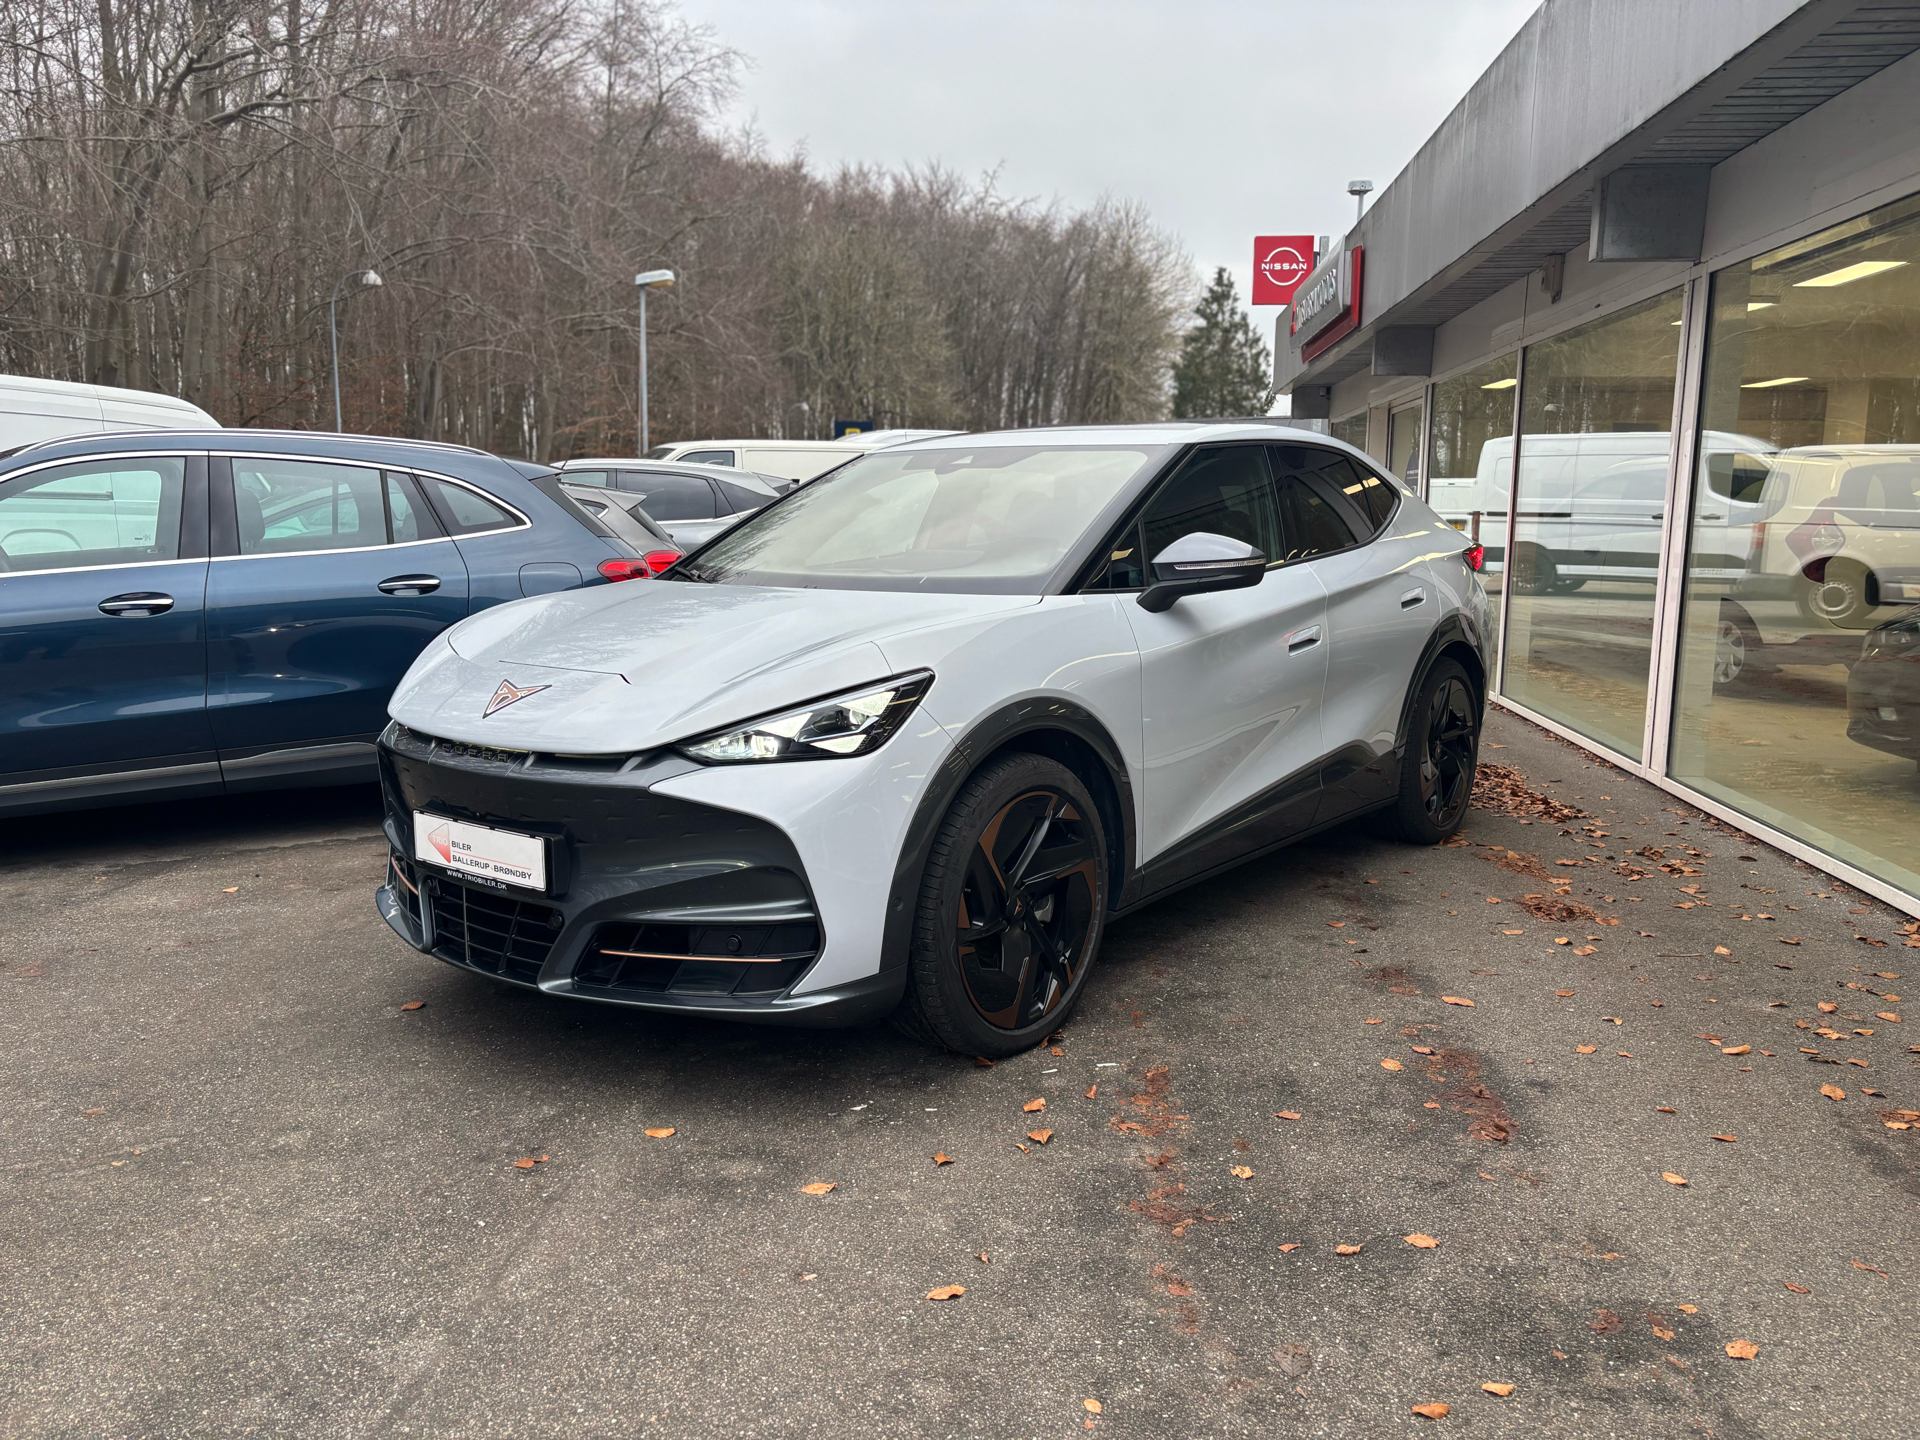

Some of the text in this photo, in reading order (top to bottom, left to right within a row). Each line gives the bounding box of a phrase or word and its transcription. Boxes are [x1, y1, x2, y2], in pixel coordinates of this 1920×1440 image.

[1261, 262, 1307, 270] NISSAN
[442, 743, 508, 763] CUPRA
[432, 835, 472, 852] TRIO BILER
[452, 854, 532, 880] BALLERUP BRØNDBY
[446, 869, 508, 890] WWW.TRIOBILER.DK
